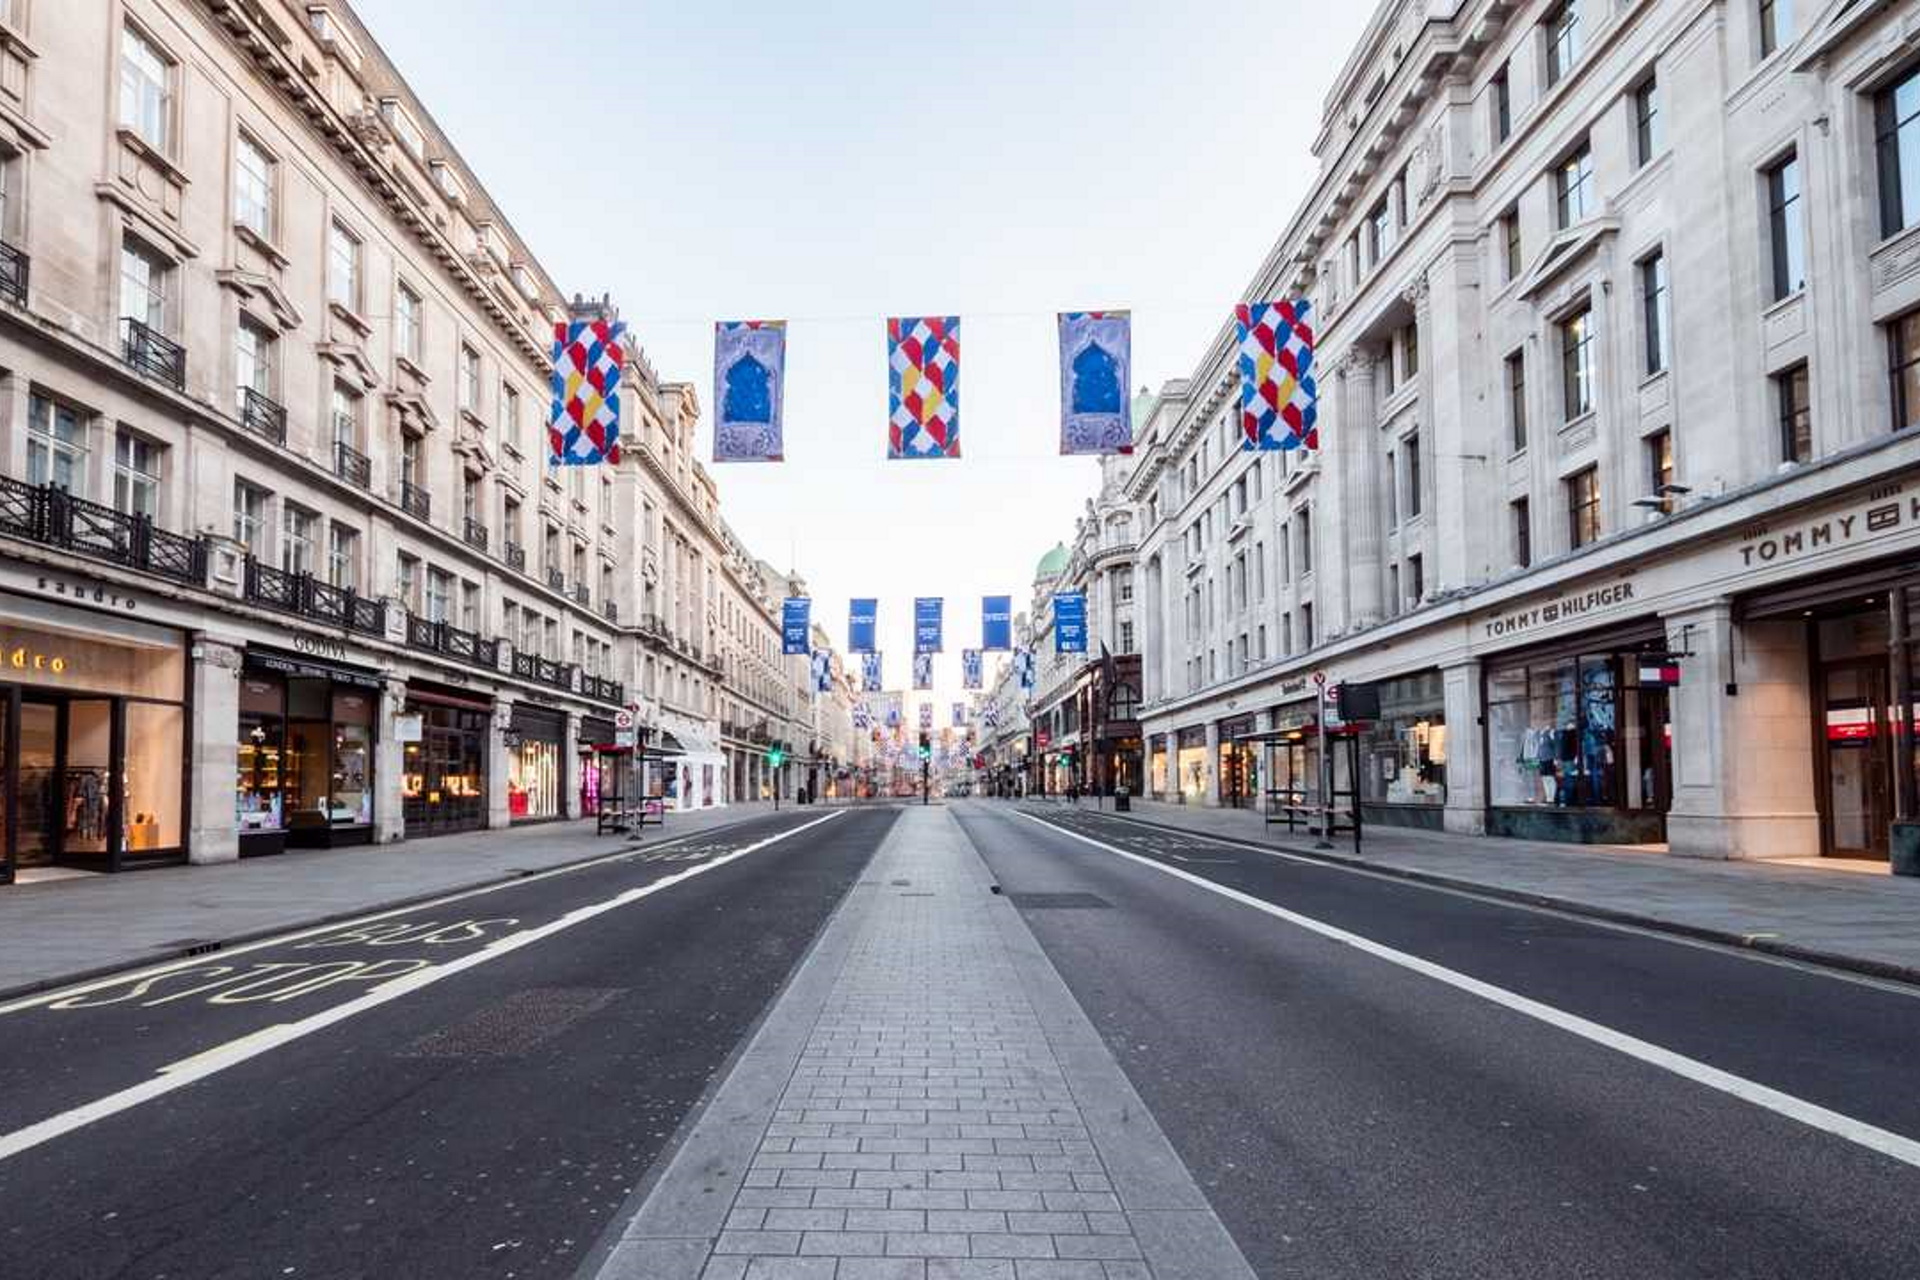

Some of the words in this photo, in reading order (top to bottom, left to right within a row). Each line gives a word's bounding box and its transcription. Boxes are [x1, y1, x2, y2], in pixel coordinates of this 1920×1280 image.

[1740, 515, 1856, 567] TOMMY
[37, 577, 136, 610] sandro
[1486, 609, 1540, 638] TOMMY
[1562, 582, 1634, 616] HILFIGER
[0, 646, 65, 673] dro
[293, 635, 346, 660] GODIVA
[295, 918, 520, 949] BUS
[48, 958, 431, 1010] STOP
